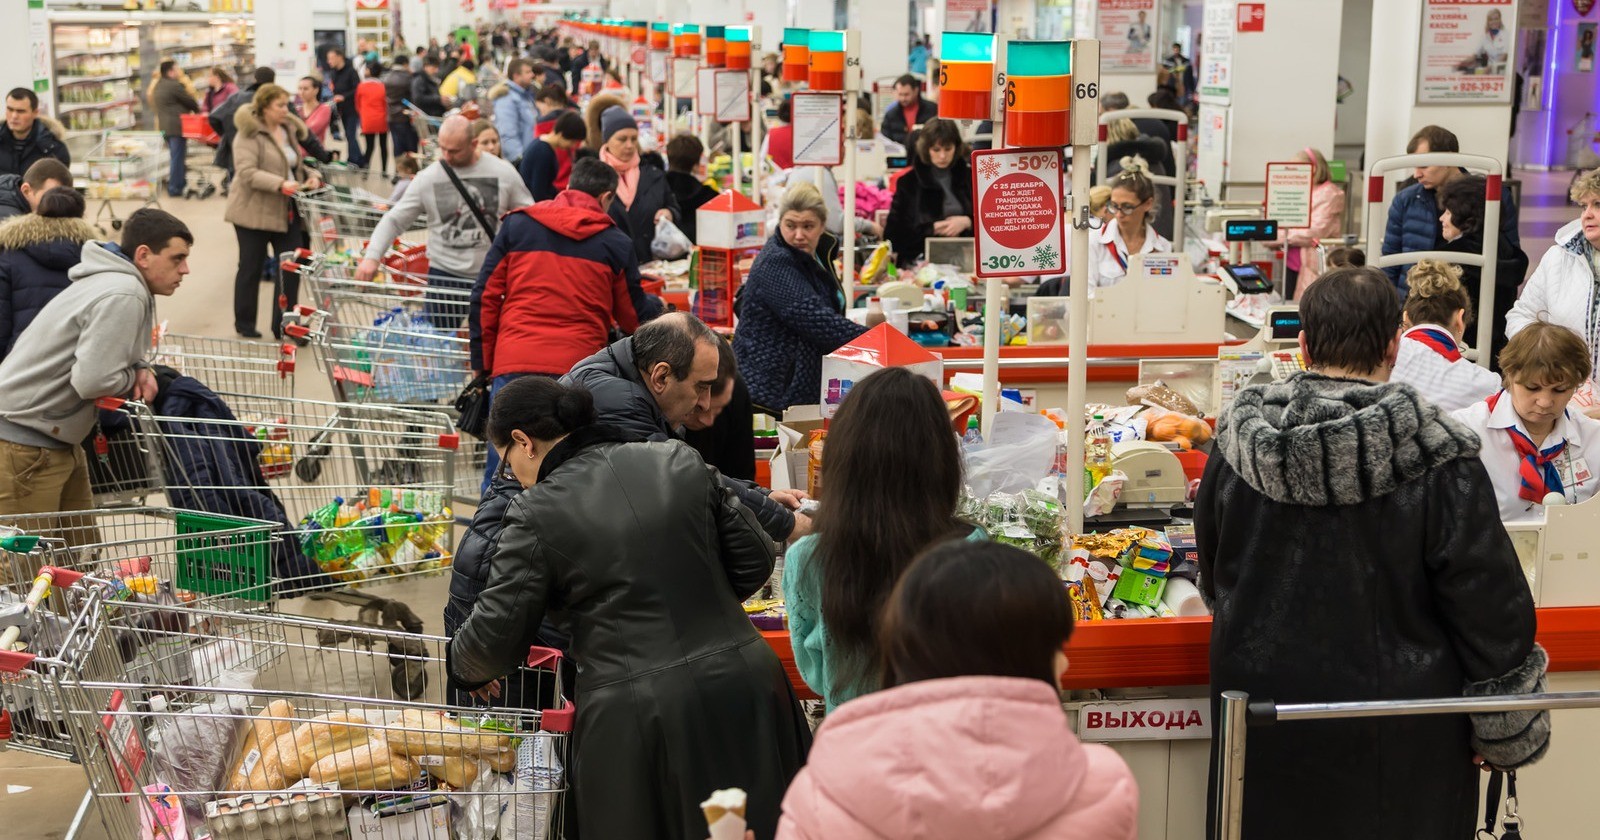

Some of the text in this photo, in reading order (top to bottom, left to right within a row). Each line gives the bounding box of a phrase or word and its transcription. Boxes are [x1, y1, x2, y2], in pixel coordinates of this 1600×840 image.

[847, 57, 860, 66] 64
[1075, 82, 1098, 100] 66
[1010, 155, 1057, 171] -50%
[1010, 181, 1044, 189] ДЕКАБРЯ
[1016, 189, 1035, 197] ЖДЕТ
[995, 196, 1043, 204] ГРАНДИОЗНАЯ
[1004, 217, 1035, 225] ДЕТСКОЙ
[982, 255, 1025, 269] -30%
[1086, 709, 1203, 731] ВЫХОДА
